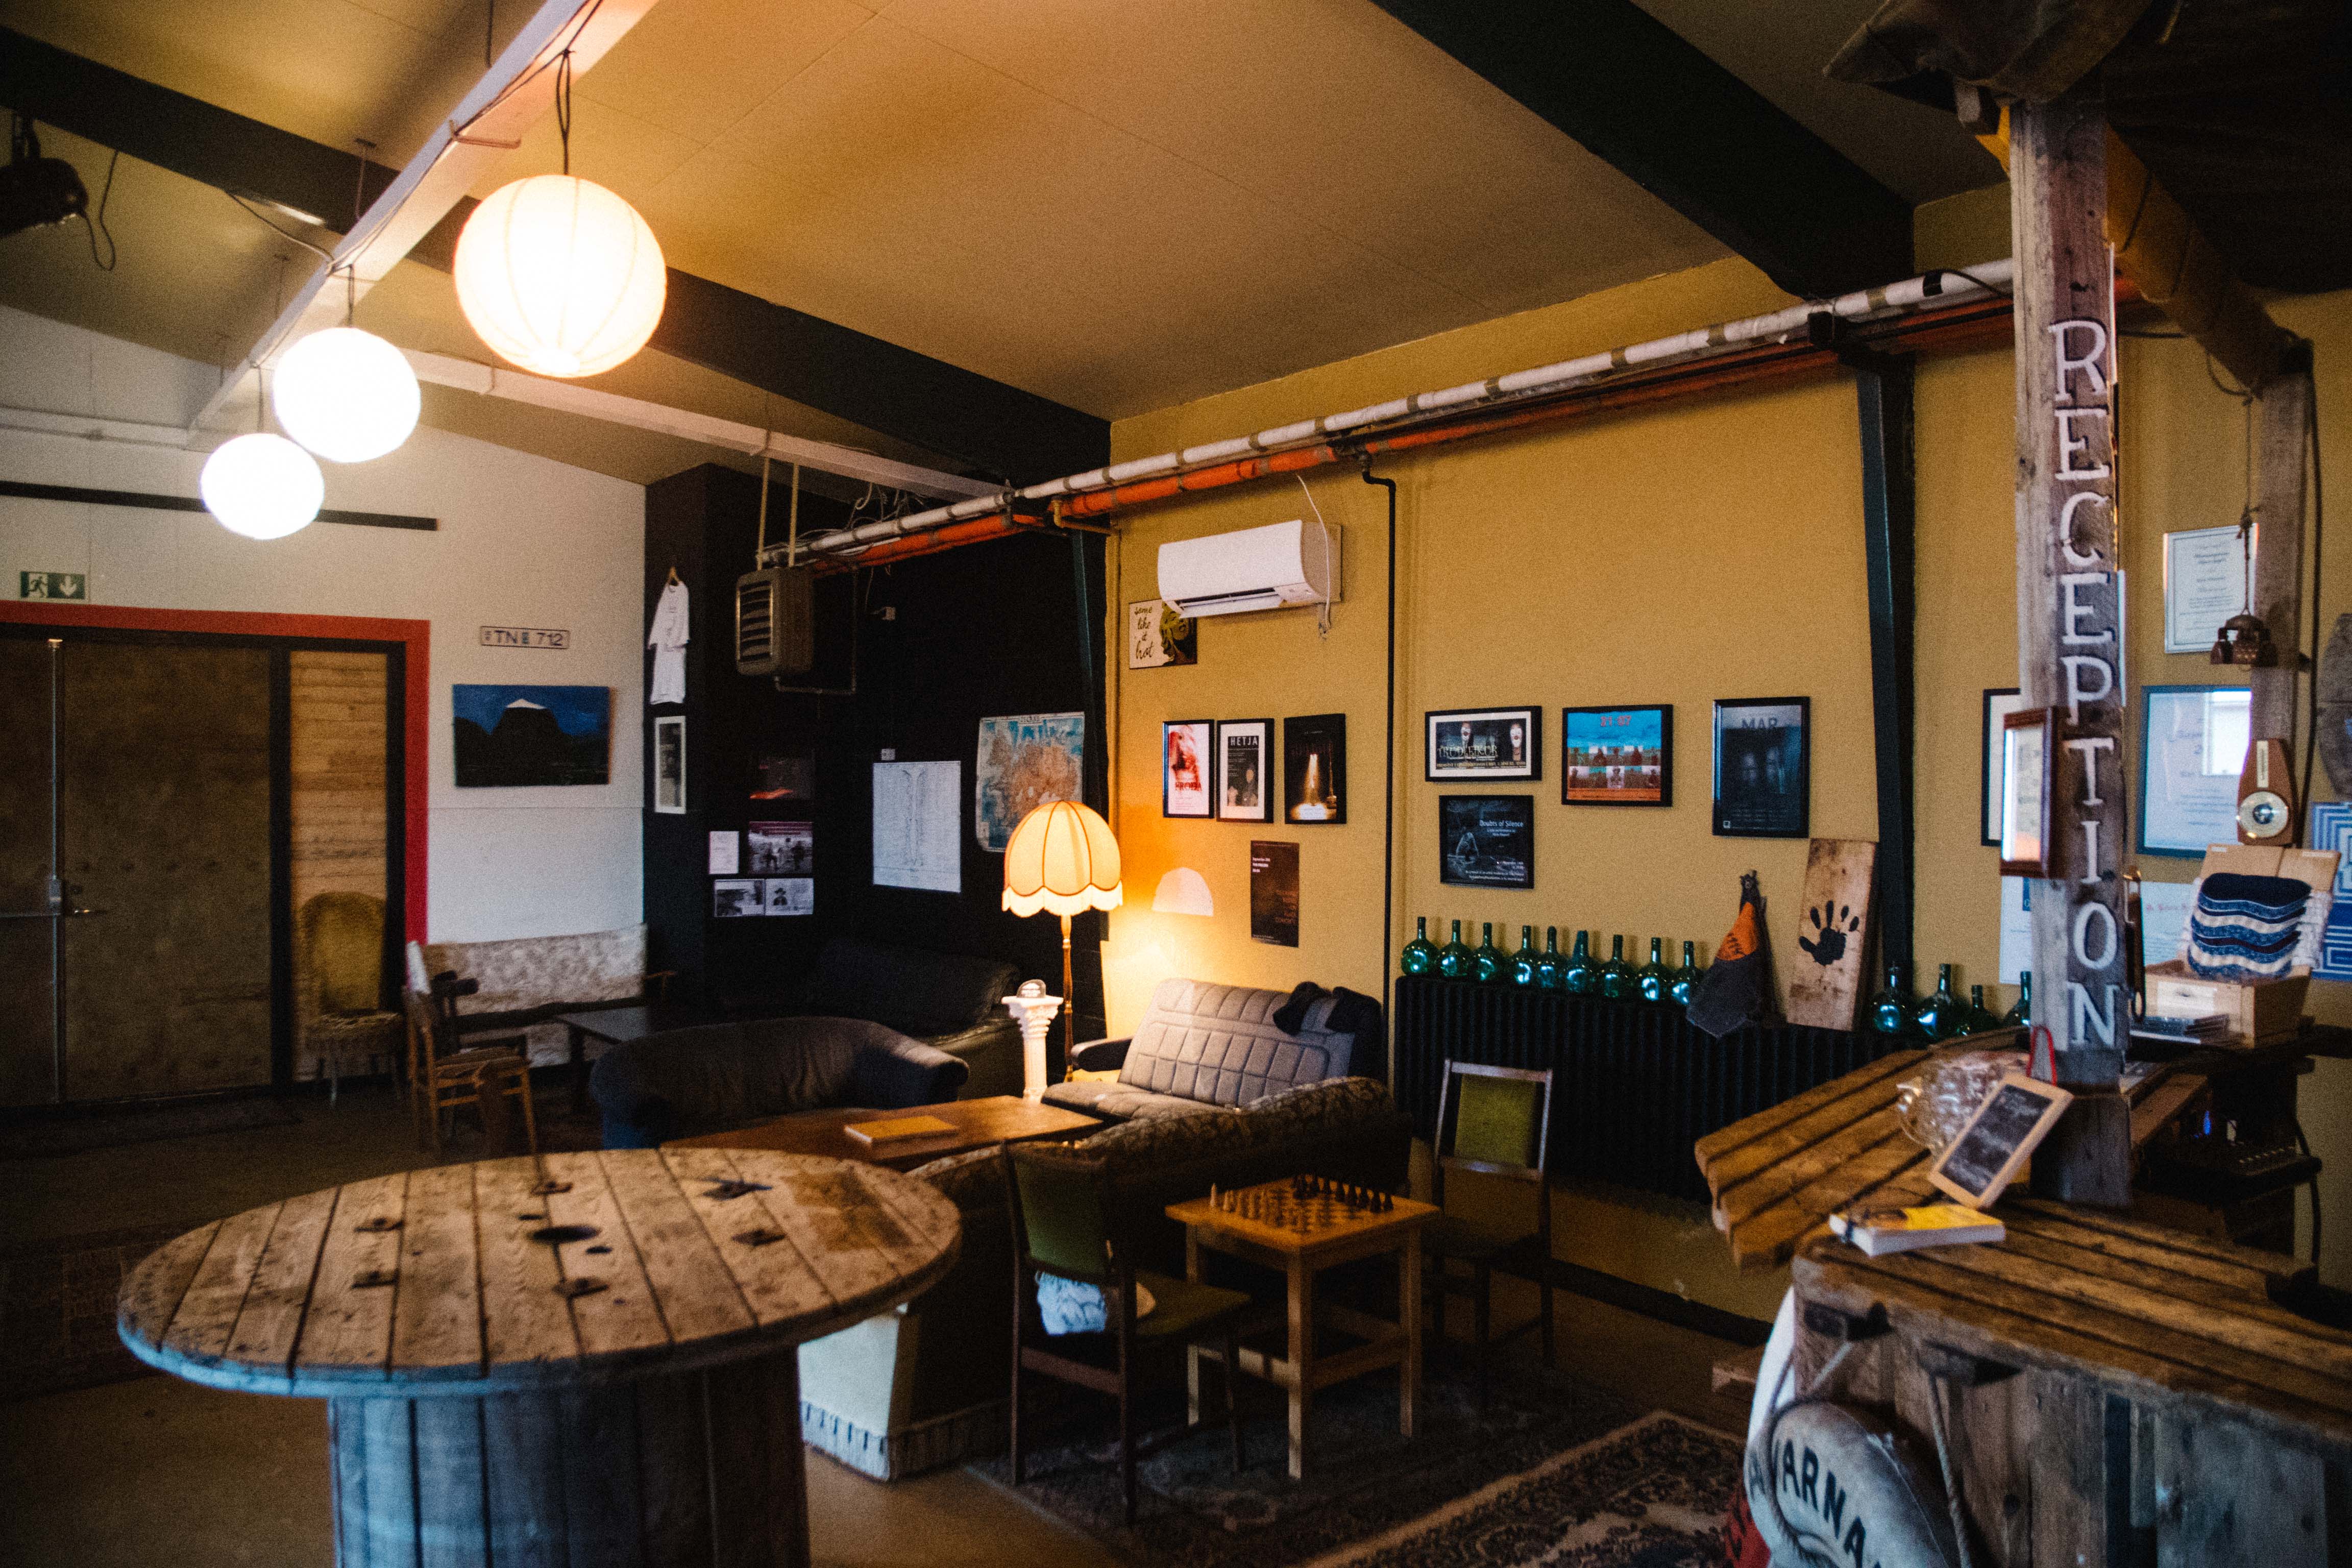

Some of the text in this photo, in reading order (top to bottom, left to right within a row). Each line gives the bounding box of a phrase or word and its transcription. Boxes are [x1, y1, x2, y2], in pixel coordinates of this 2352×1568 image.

[1134, 606, 1153, 615] some
[1137, 616, 1151, 629] like
[1136, 641, 1154, 660] hot
[2048, 320, 2120, 1047] RECEPTION
[1601, 715, 1632, 727] 21:07
[1231, 736, 1258, 746] HETJA
